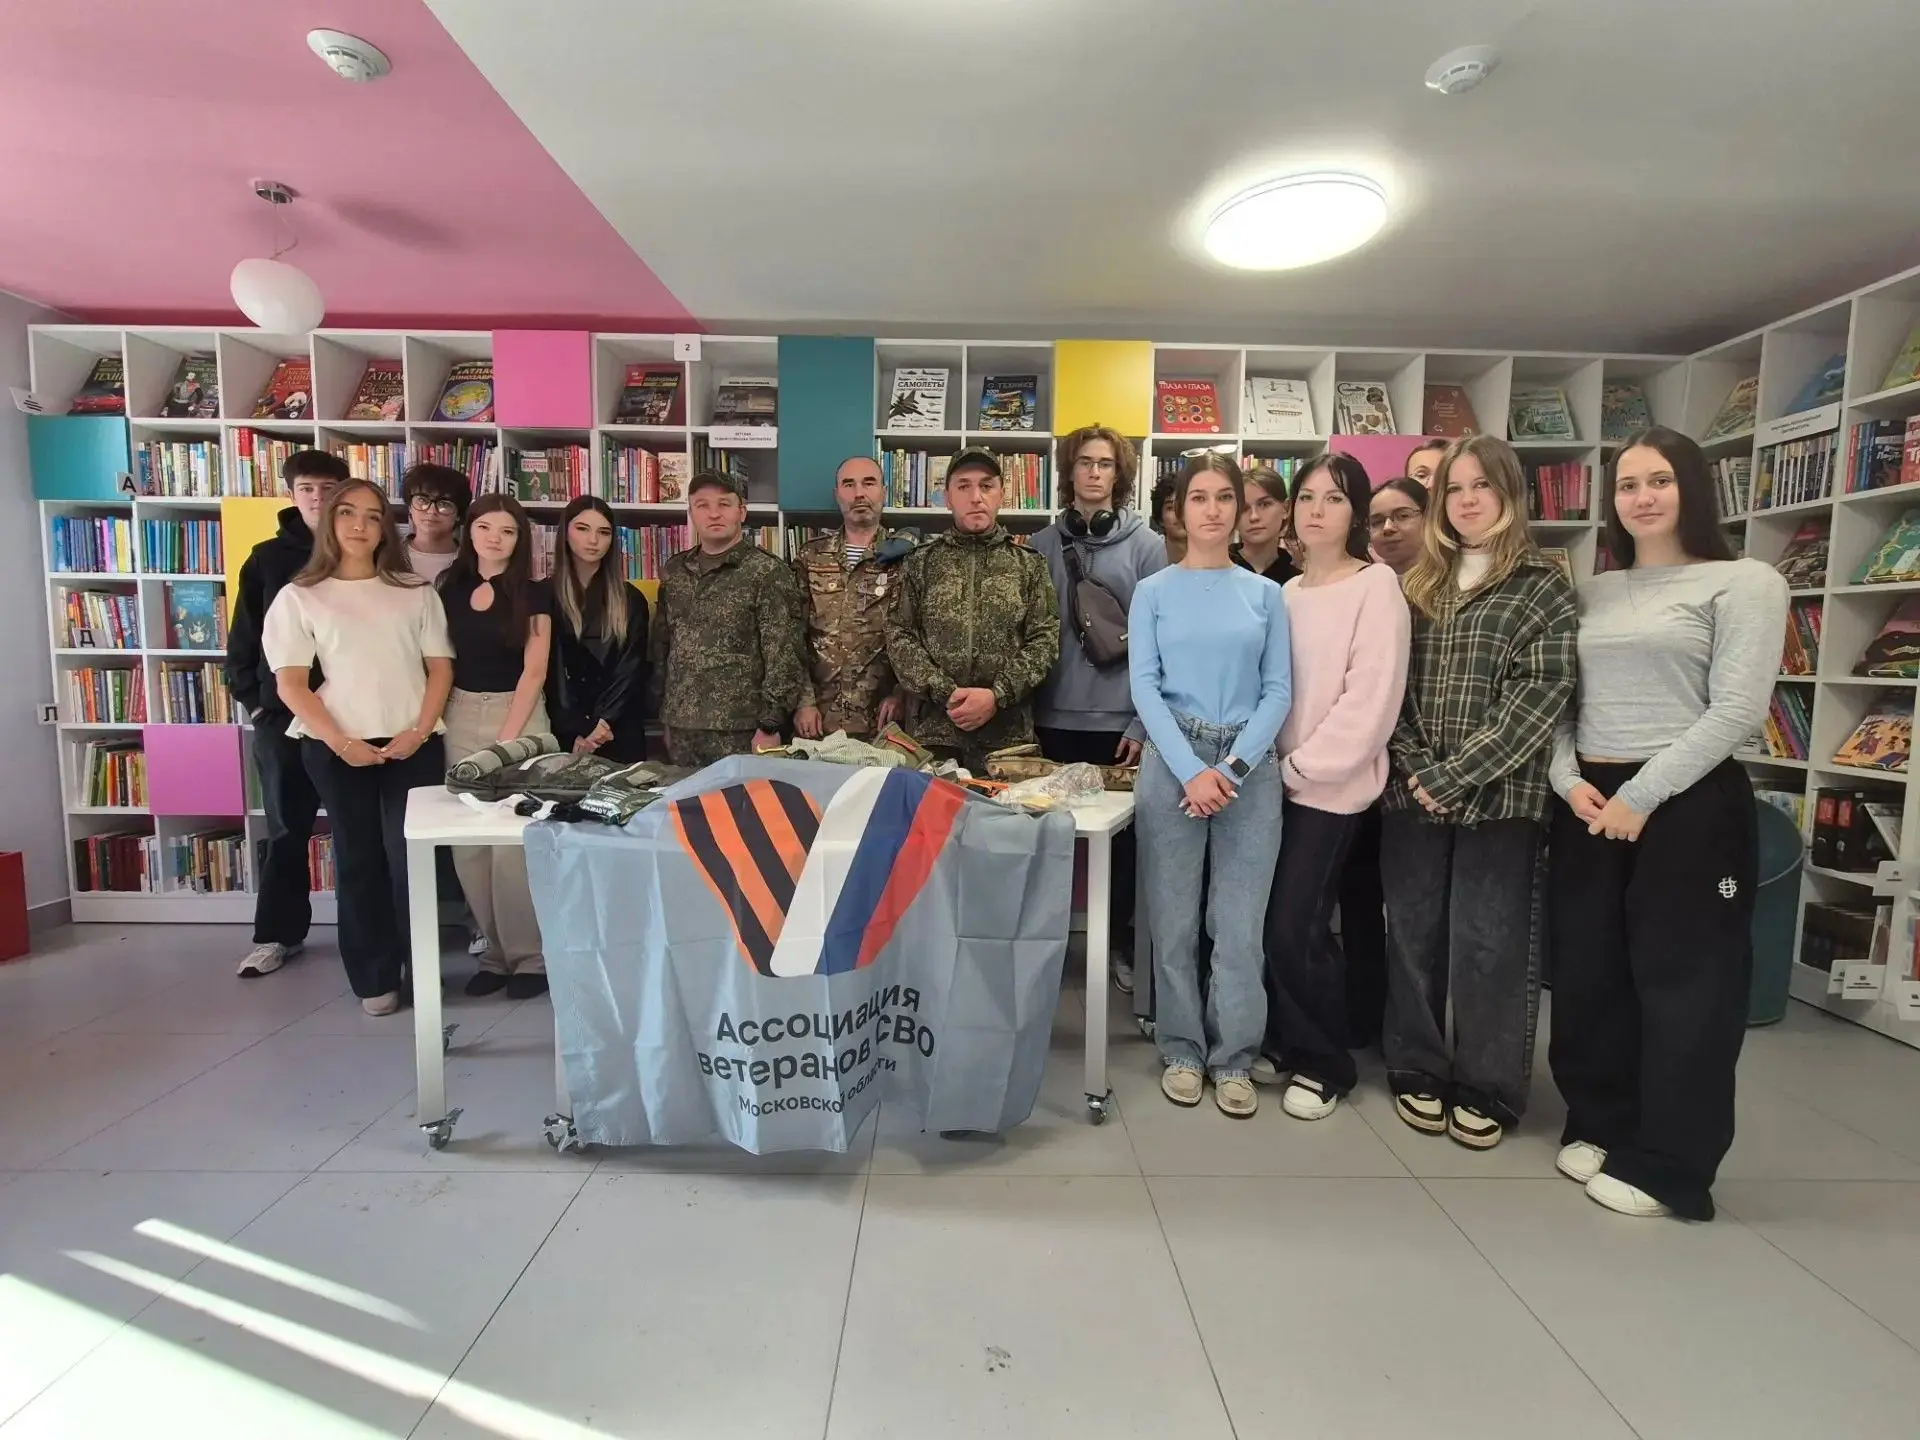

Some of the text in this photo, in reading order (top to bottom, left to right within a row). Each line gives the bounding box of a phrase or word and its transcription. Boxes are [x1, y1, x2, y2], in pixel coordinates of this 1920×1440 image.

[684, 343, 691, 351] 2
[122, 476, 137, 493] А
[80, 629, 96, 648] Д
[716, 984, 921, 1046] Ассоциация
[697, 1014, 935, 1089] ветеранов СВО
